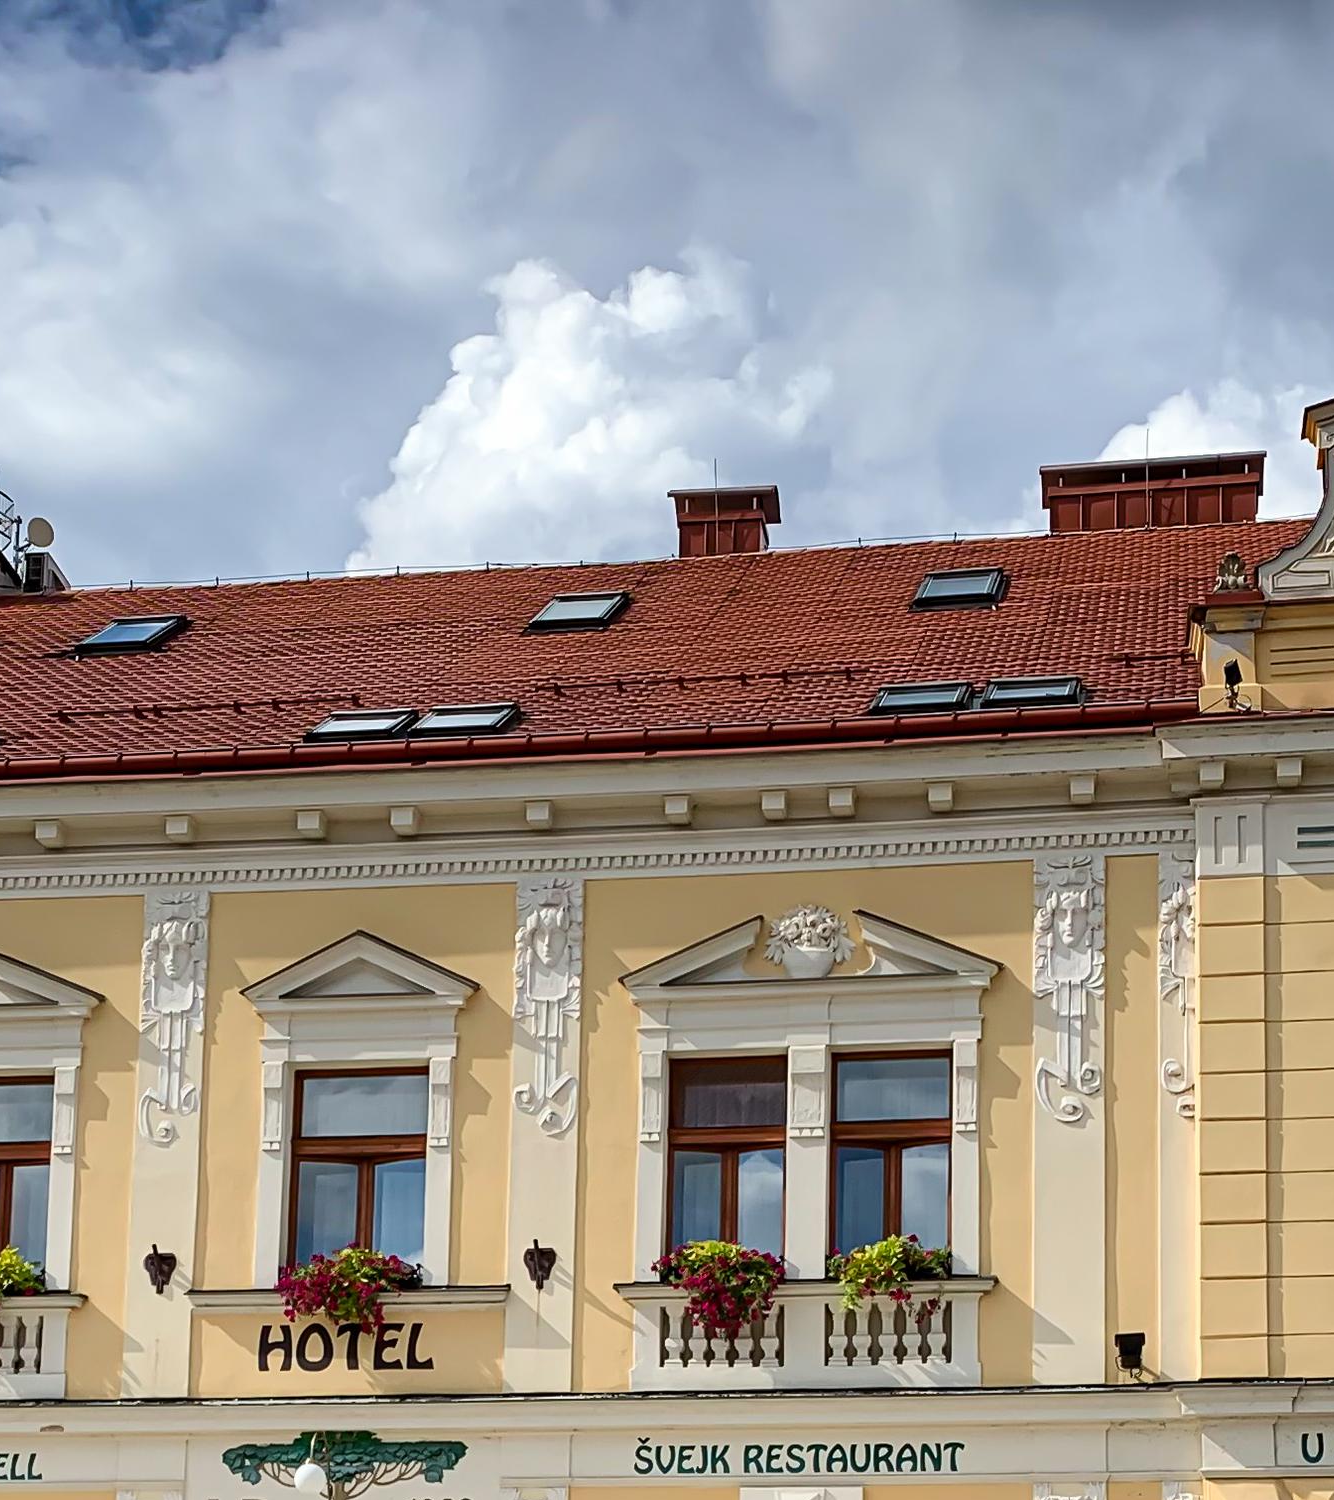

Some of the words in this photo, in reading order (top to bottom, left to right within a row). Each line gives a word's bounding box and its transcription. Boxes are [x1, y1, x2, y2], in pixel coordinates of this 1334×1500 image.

[257, 1322, 435, 1372] HOTEL
[633, 1437, 731, 1475] ŠVEJK
[743, 1441, 965, 1474] RESTAURANT
[1300, 1432, 1325, 1464] U
